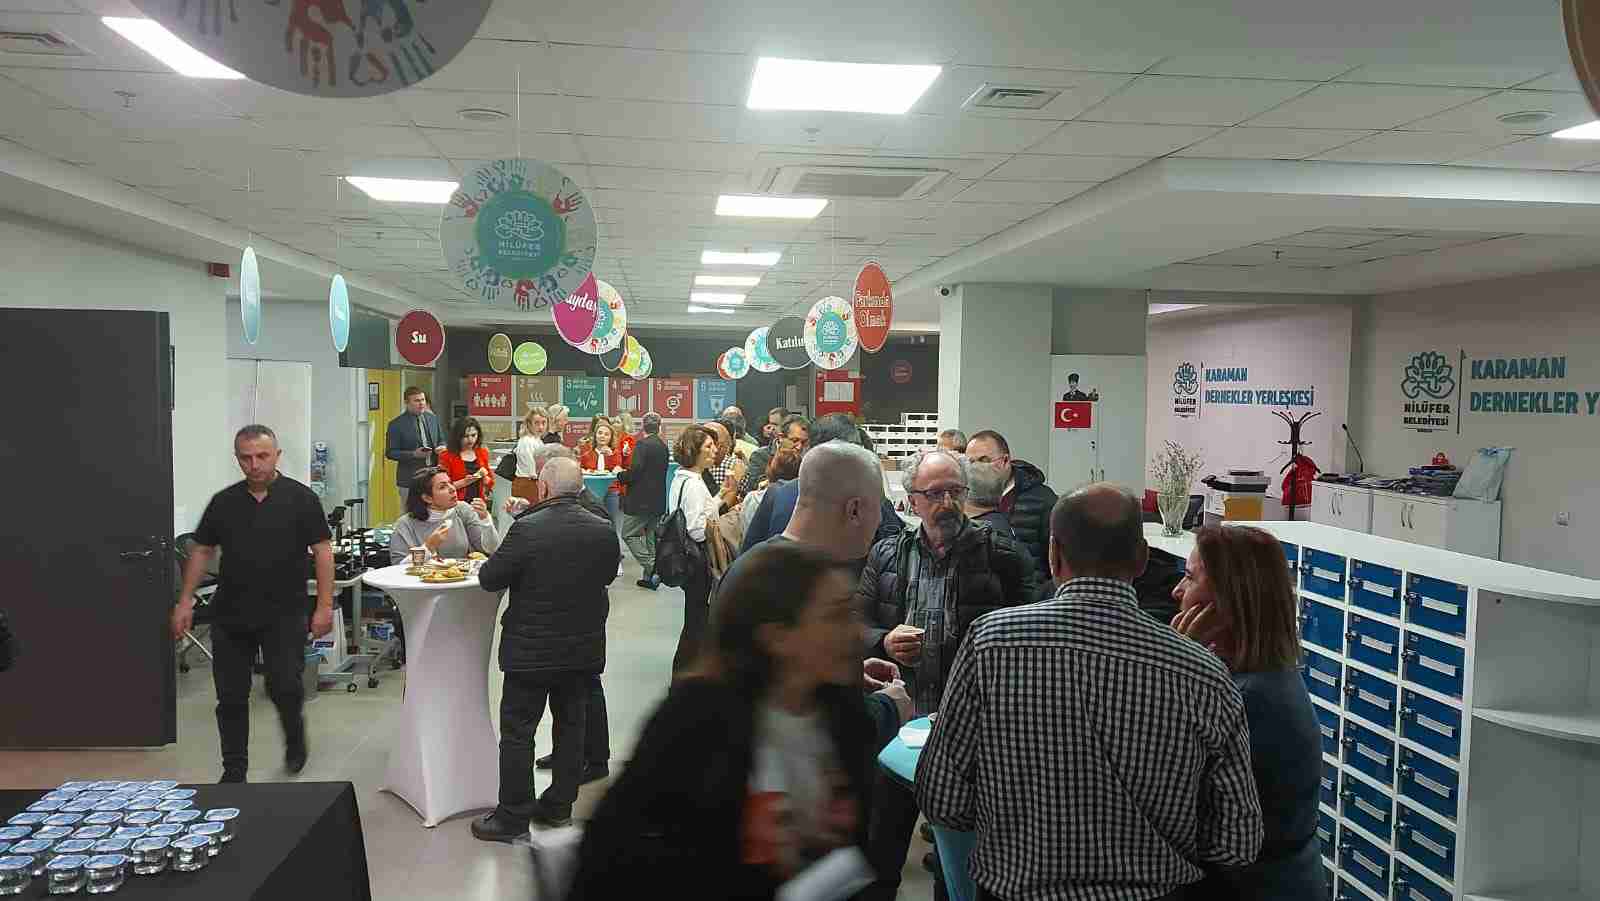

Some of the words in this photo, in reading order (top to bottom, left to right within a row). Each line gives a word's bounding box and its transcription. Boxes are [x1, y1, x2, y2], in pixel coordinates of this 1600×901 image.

[411, 331, 427, 344] Su
[1205, 368, 1248, 382] KARAMAN
[1471, 357, 1566, 379] KARAMAN
[1205, 390, 1253, 404] DERNEKLER
[1470, 391, 1578, 414] DERNEKLER
[1403, 400, 1451, 414] NİLÜFER
